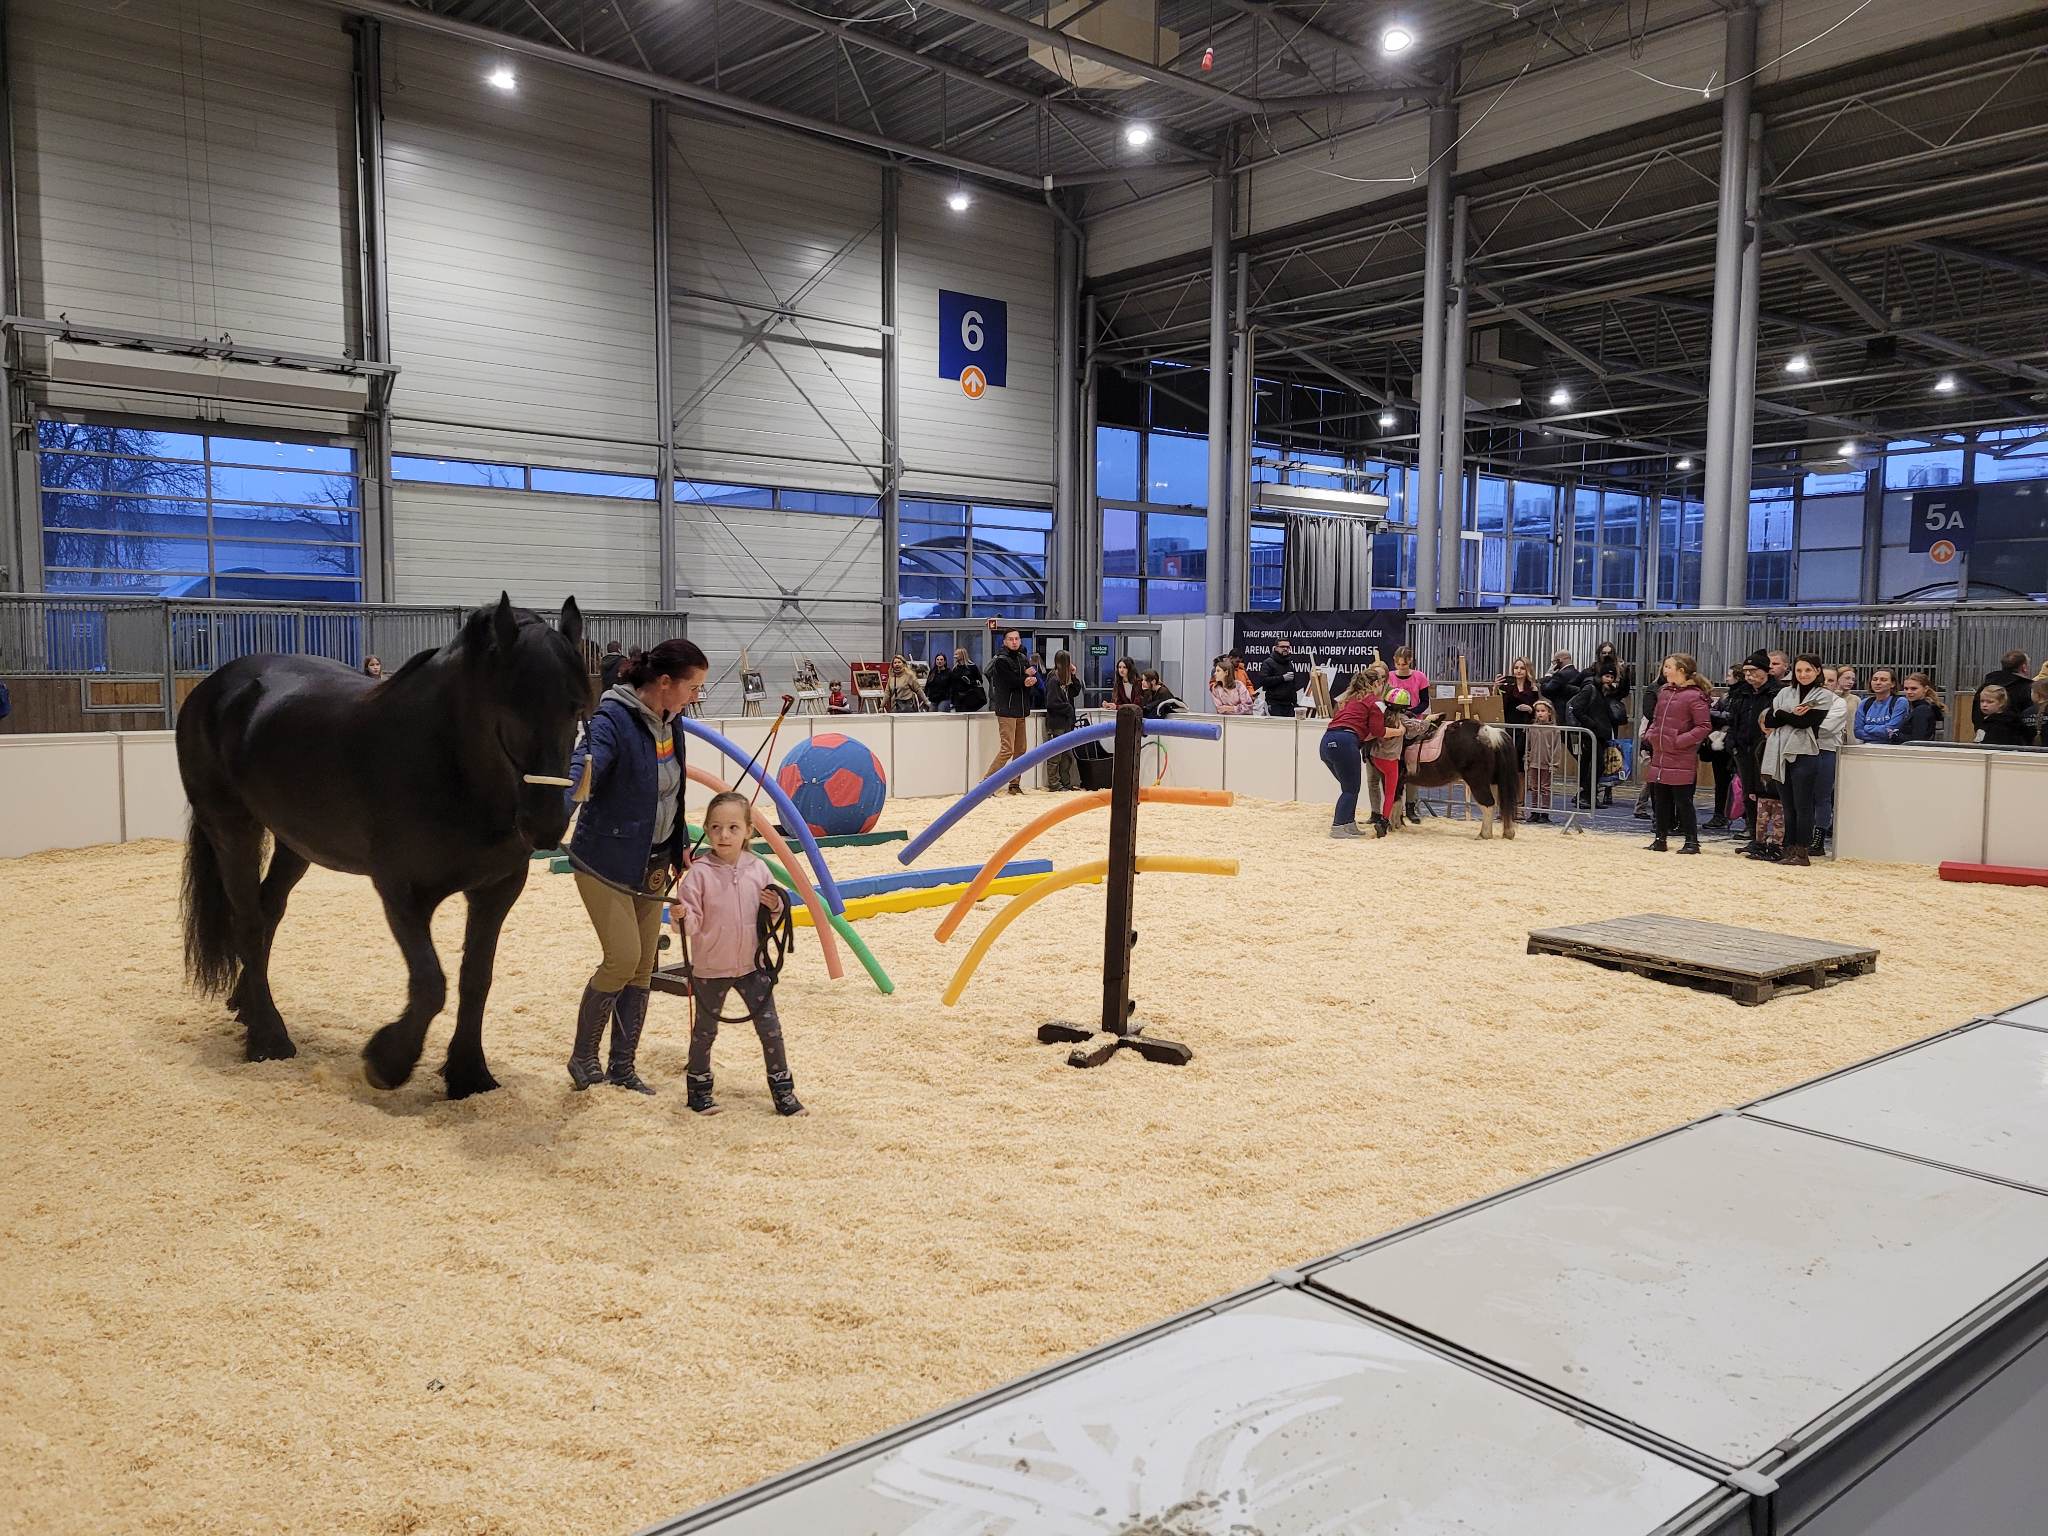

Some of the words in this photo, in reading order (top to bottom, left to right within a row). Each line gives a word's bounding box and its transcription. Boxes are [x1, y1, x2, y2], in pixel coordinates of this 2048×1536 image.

[961, 310, 985, 352] 6
[1925, 503, 1965, 531] 5A
[1242, 630, 1260, 638] TARGI
[1260, 630, 1289, 639] SPRZĘTU
[1292, 628, 1335, 638] AKCESORIÓW
[1335, 628, 1383, 639] JEŹDZIECKICH
[1244, 645, 1271, 655] ARENA
[1319, 646, 1347, 656] HOBBY
